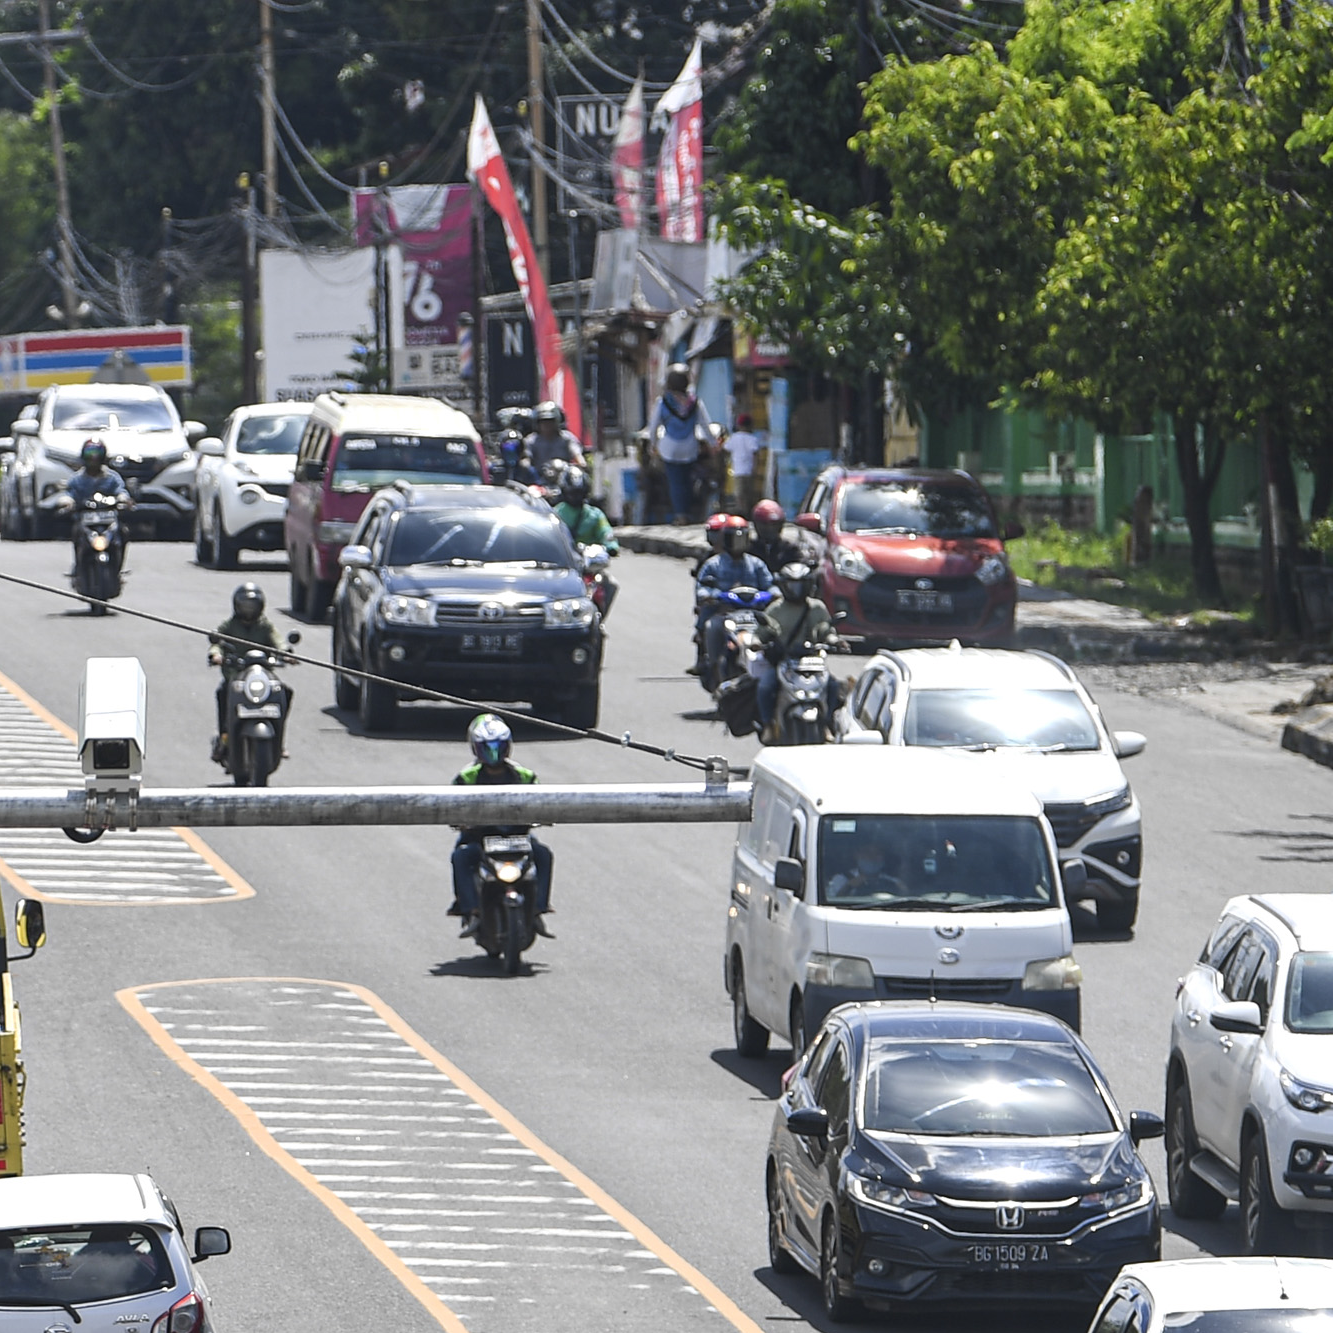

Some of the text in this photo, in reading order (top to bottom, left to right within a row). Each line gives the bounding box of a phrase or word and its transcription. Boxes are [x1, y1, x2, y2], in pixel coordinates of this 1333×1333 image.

[975, 1244, 1049, 1261] BG 1509 ZA
